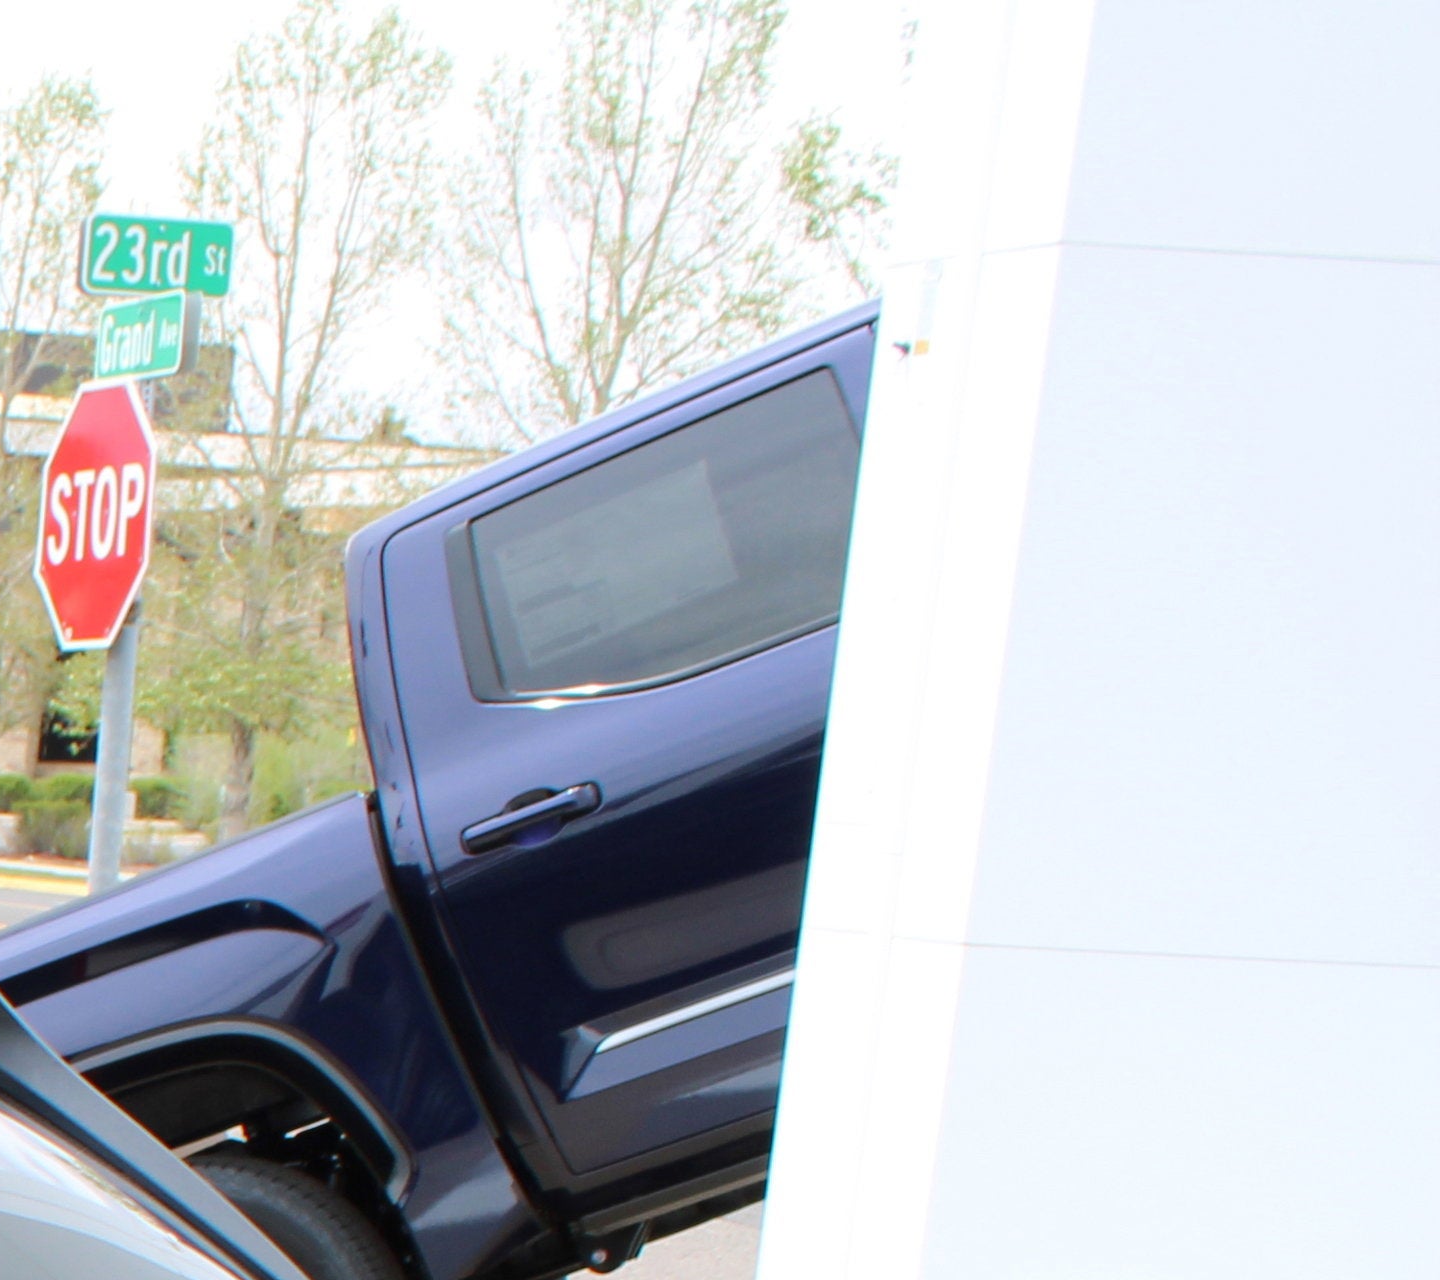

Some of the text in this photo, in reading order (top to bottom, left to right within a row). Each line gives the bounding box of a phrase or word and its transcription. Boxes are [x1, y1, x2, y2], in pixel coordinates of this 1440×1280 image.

[90, 221, 226, 287] 23rd St
[98, 308, 178, 374] Grand Ave
[46, 462, 145, 567] STOP
